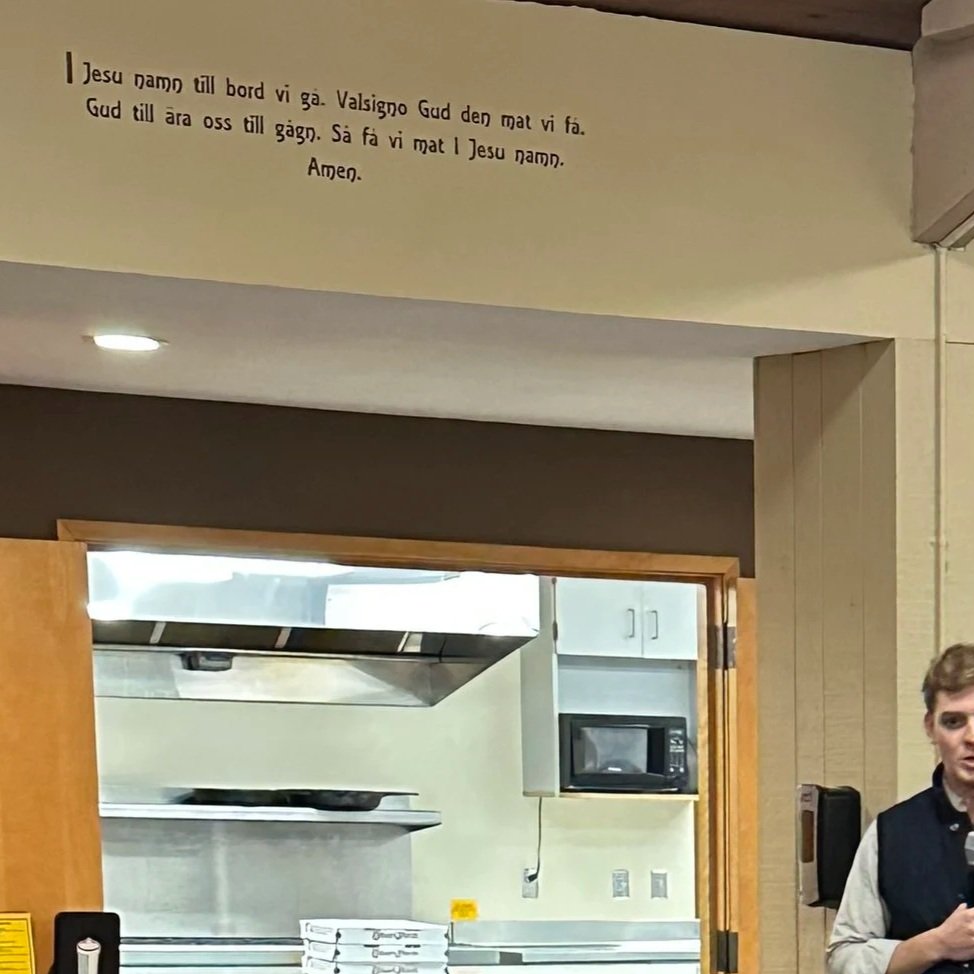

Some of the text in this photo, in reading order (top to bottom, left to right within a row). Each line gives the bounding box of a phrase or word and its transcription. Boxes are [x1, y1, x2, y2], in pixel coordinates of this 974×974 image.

[65, 51, 73, 85] I
[83, 61, 123, 85] Jesu
[134, 73, 183, 94] namn
[193, 75, 215, 95] till
[226, 77, 265, 100] bord
[275, 84, 290, 104] vi
[336, 89, 408, 120] Valsigno
[418, 100, 451, 121] Gud
[461, 105, 491, 128] den
[501, 113, 533, 131] mat
[541, 115, 555, 133] vi
[86, 97, 122, 120] Gud
[132, 103, 155, 123] till
[203, 115, 233, 131] oss
[243, 115, 265, 135] till
[275, 119, 322, 146] gågn.
[331, 123, 352, 144] Så
[362, 125, 379, 147] få
[389, 130, 403, 150] vi
[413, 136, 446, 155] mat
[469, 137, 507, 161] Jesu
[514, 148, 565, 169] namn.
[307, 156, 362, 184] Amen.
